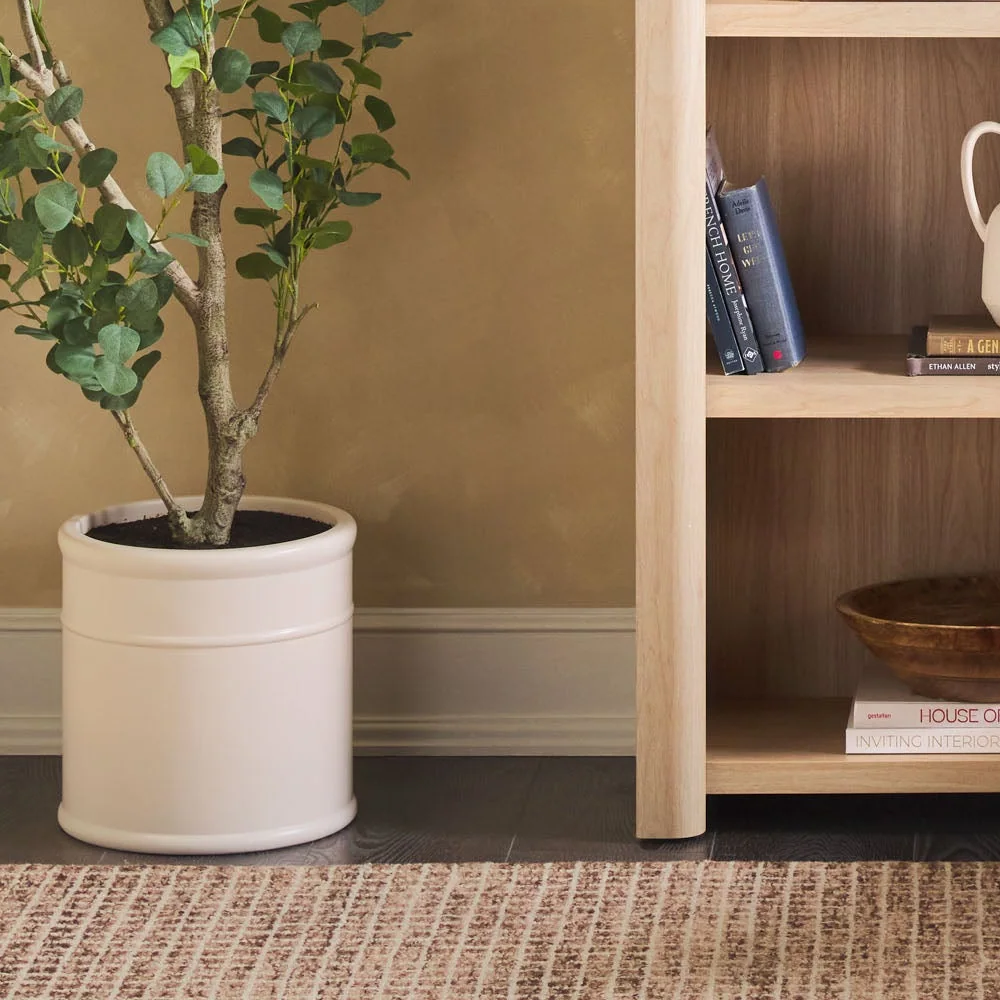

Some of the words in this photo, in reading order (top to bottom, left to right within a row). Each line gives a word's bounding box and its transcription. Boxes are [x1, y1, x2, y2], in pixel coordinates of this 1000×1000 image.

[706, 193, 723, 248] ENCH
[715, 251, 737, 296] HOME
[740, 326, 748, 341] Ryan
[967, 339, 974, 353] A
[920, 708, 979, 723] HOUSE
[856, 735, 922, 748] INVITING
